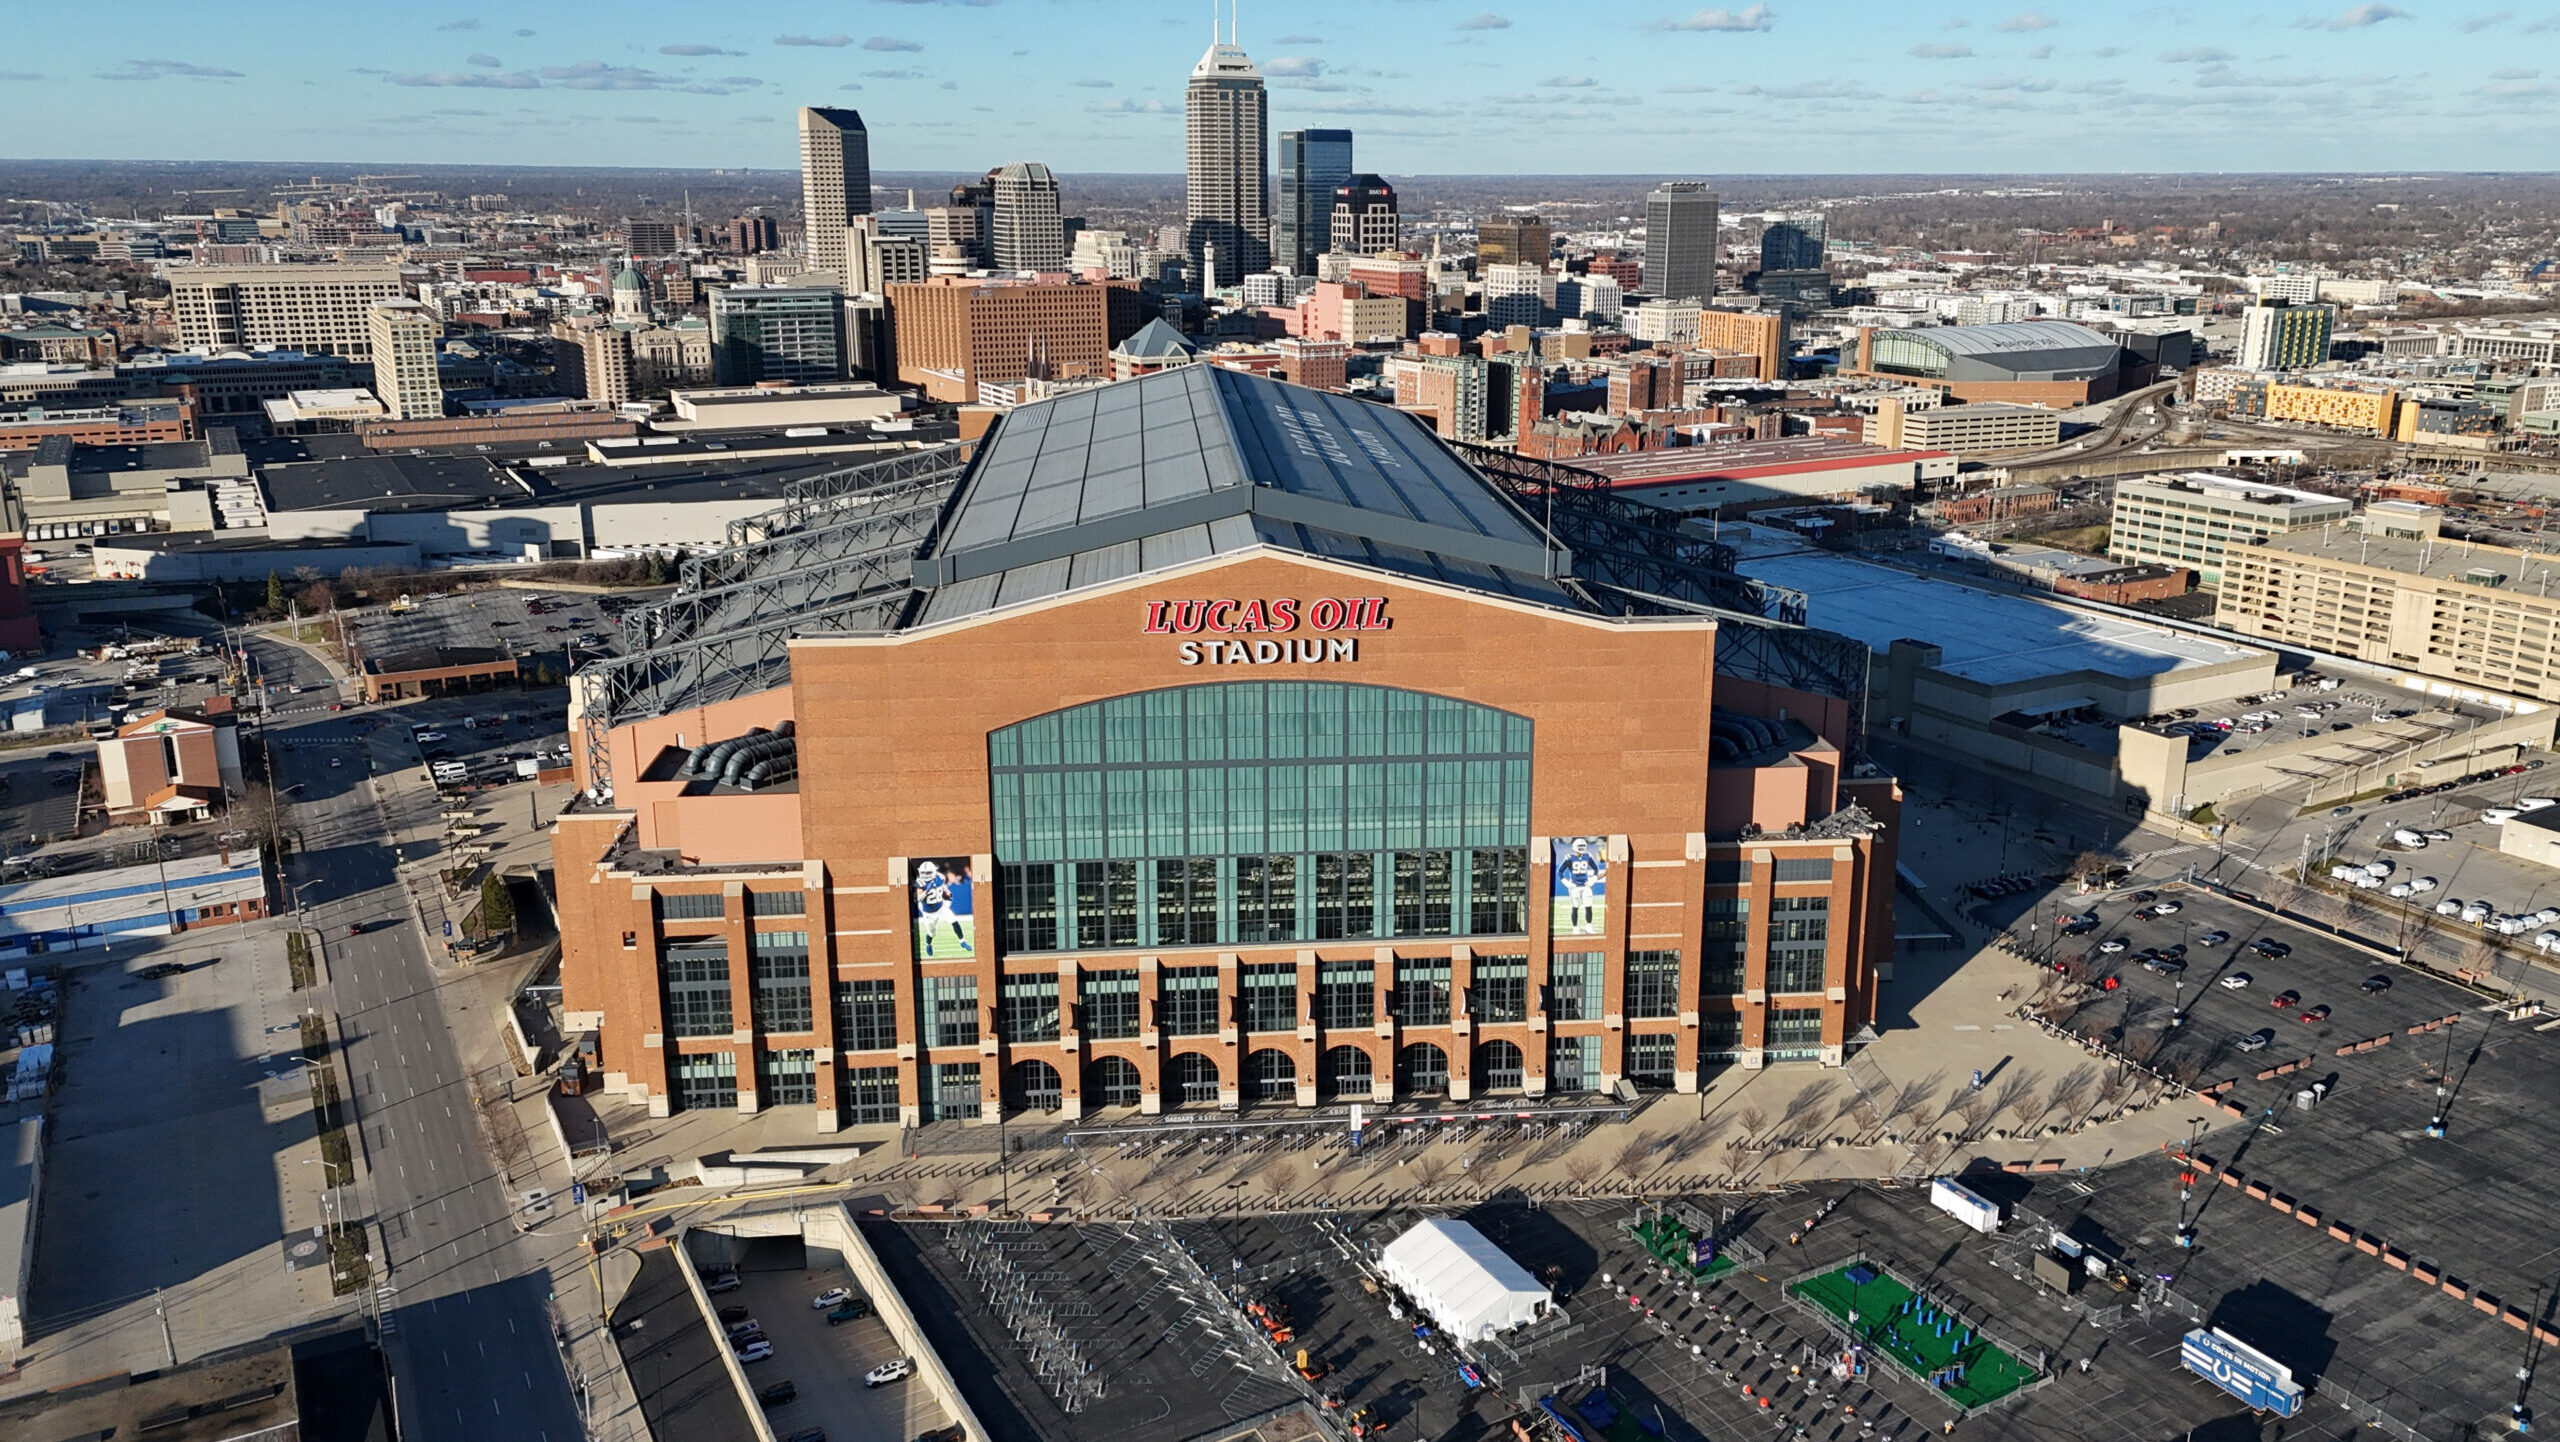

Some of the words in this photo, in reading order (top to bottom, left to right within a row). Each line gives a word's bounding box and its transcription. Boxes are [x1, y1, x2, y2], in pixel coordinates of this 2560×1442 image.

[1144, 598, 1298, 632] LUCAS
[1309, 597, 1391, 631] OIL
[1179, 638, 1355, 665] STADIUM
[1572, 860, 1589, 875] 99
[927, 886, 944, 905] 28
[2211, 1343, 2233, 1360] COLTS
[2234, 1356, 2243, 1366] IN
[2243, 1361, 2272, 1382] MOTION
